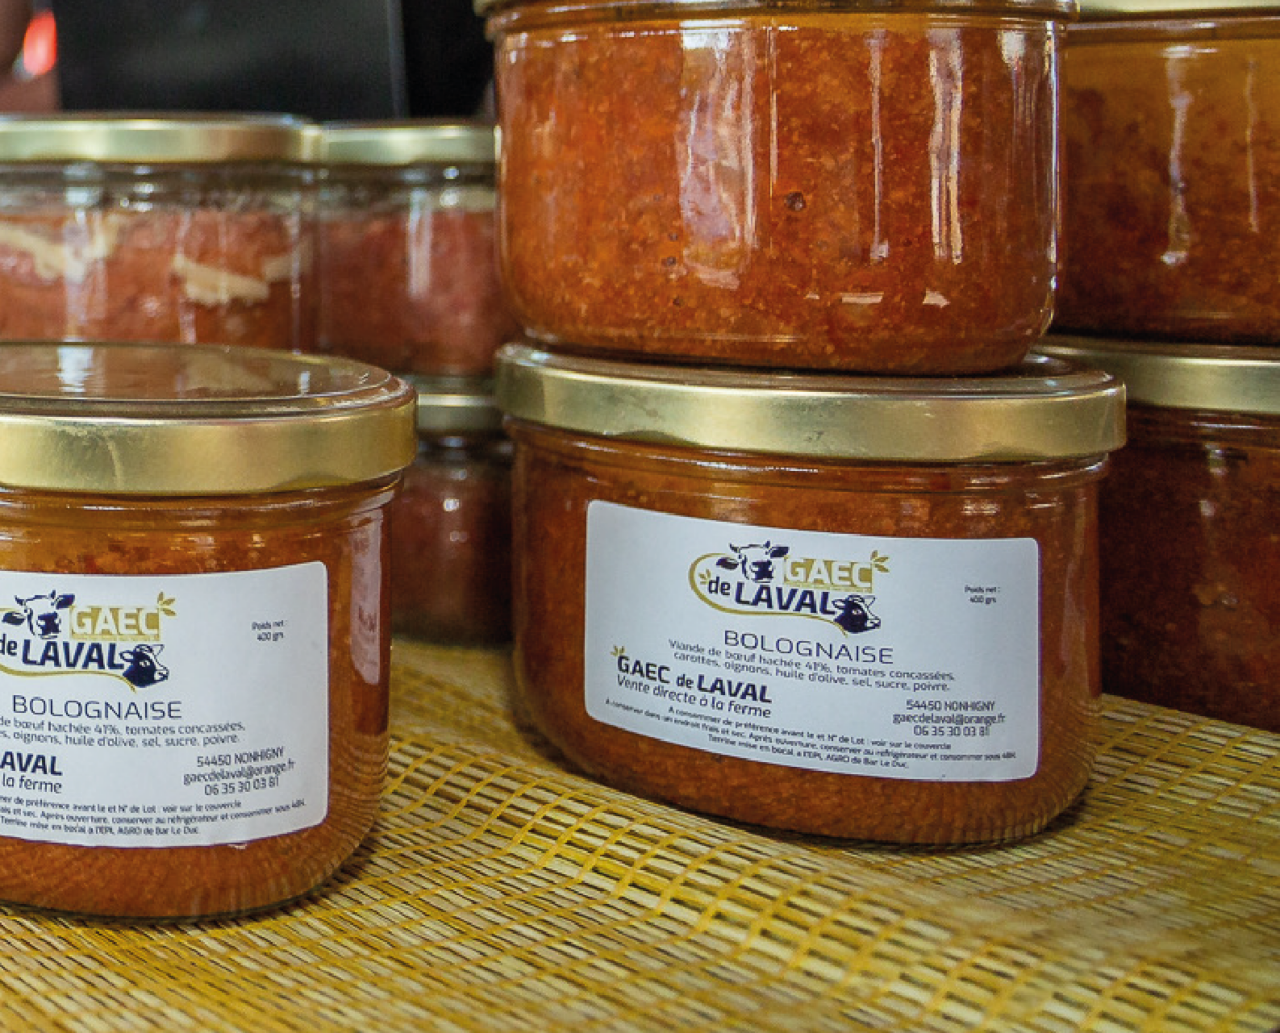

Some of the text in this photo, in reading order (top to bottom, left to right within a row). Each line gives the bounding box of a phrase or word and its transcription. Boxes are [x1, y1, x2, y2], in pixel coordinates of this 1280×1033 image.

[783, 557, 872, 589] GAEC
[708, 576, 836, 616] de LAVAL
[70, 607, 161, 638] GAEC
[22, 639, 124, 670] LAVAL
[668, 638, 705, 655] Viande
[708, 647, 722, 657] de
[724, 648, 756, 663] bœuf
[759, 653, 802, 670] hachée
[836, 663, 886, 678] tomates
[724, 629, 894, 665] BOLOGNAISE
[617, 655, 773, 704] GAEC de LAVAL
[775, 667, 805, 681] huile
[12, 694, 182, 721] BOLOGNAISE
[617, 674, 772, 720] Vente directe à la ferme
[906, 698, 942, 712] 54450
[13, 717, 45, 733] bœuf
[48, 721, 91, 736] hachée
[126, 724, 175, 736] tomates
[65, 733, 95, 747] huile
[913, 725, 929, 737] 06
[931, 726, 945, 737] 35
[947, 725, 961, 737] 30
[963, 725, 977, 737] 03
[197, 754, 232, 768] 54450
[2, 771, 15, 789] la
[19, 774, 63, 795] ferme
[205, 783, 219, 796] 06
[222, 782, 236, 795] 35
[238, 780, 251, 793] 30
[253, 778, 267, 791] 03
